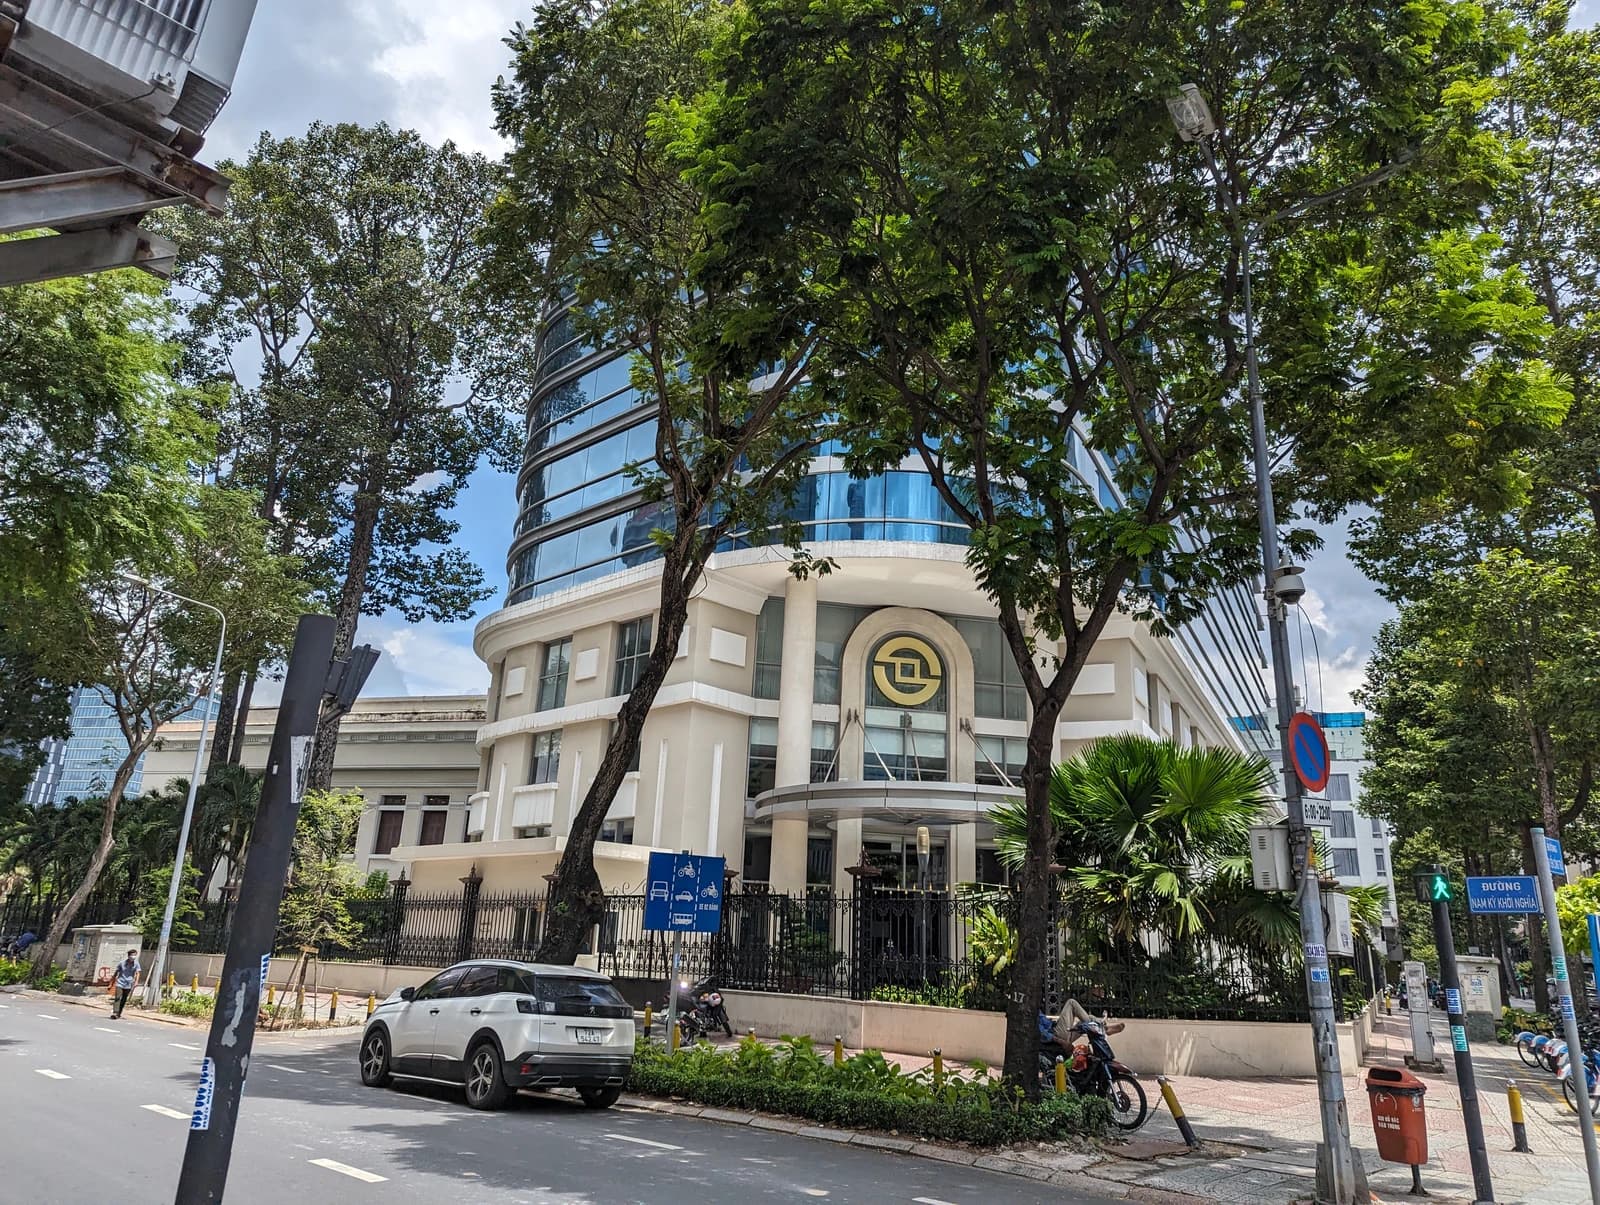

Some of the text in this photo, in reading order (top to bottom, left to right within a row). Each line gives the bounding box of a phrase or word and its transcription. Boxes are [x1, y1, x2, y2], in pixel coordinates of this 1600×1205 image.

[1481, 881, 1521, 891] ĐƯỜNG
[1471, 897, 1486, 909] NAM
[1498, 894, 1514, 909] KHỞI
[1515, 894, 1537, 909] NGHĨA
